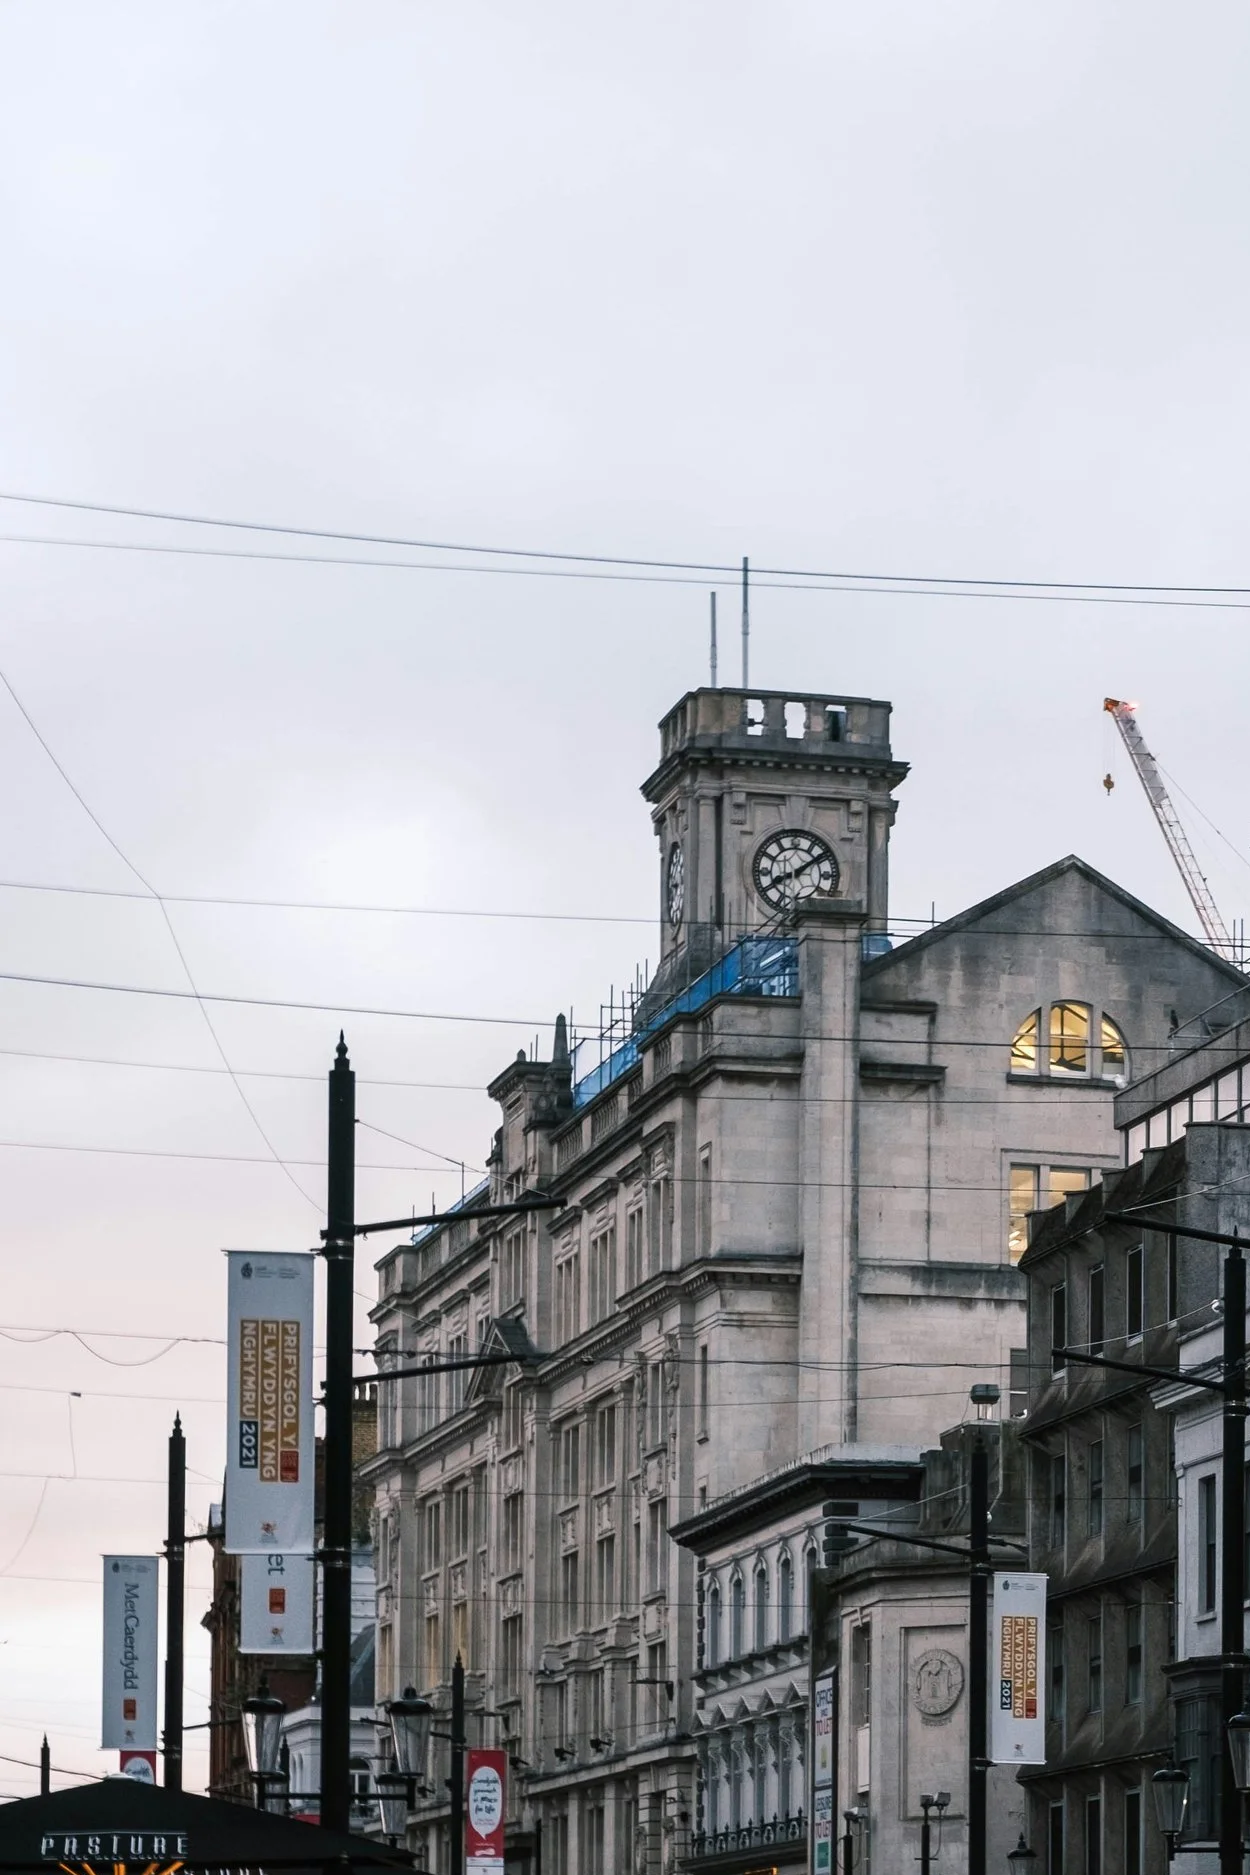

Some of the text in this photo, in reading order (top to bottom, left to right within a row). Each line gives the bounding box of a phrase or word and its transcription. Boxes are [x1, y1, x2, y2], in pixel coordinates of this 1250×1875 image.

[242, 1322, 257, 1467] NGHYMRU 2021
[262, 1323, 277, 1479] FLWYDDYN YNG
[283, 1324, 298, 1428] PRIFYSGOL
[283, 1431, 297, 1446] Y
[1002, 1617, 1011, 1709] NGHYMRU 2021
[1014, 1618, 1024, 1717] FLWYDDYN YNG
[1027, 1618, 1036, 1684] PRIFYSGOL
[41, 1835, 189, 1856] PASTURE
